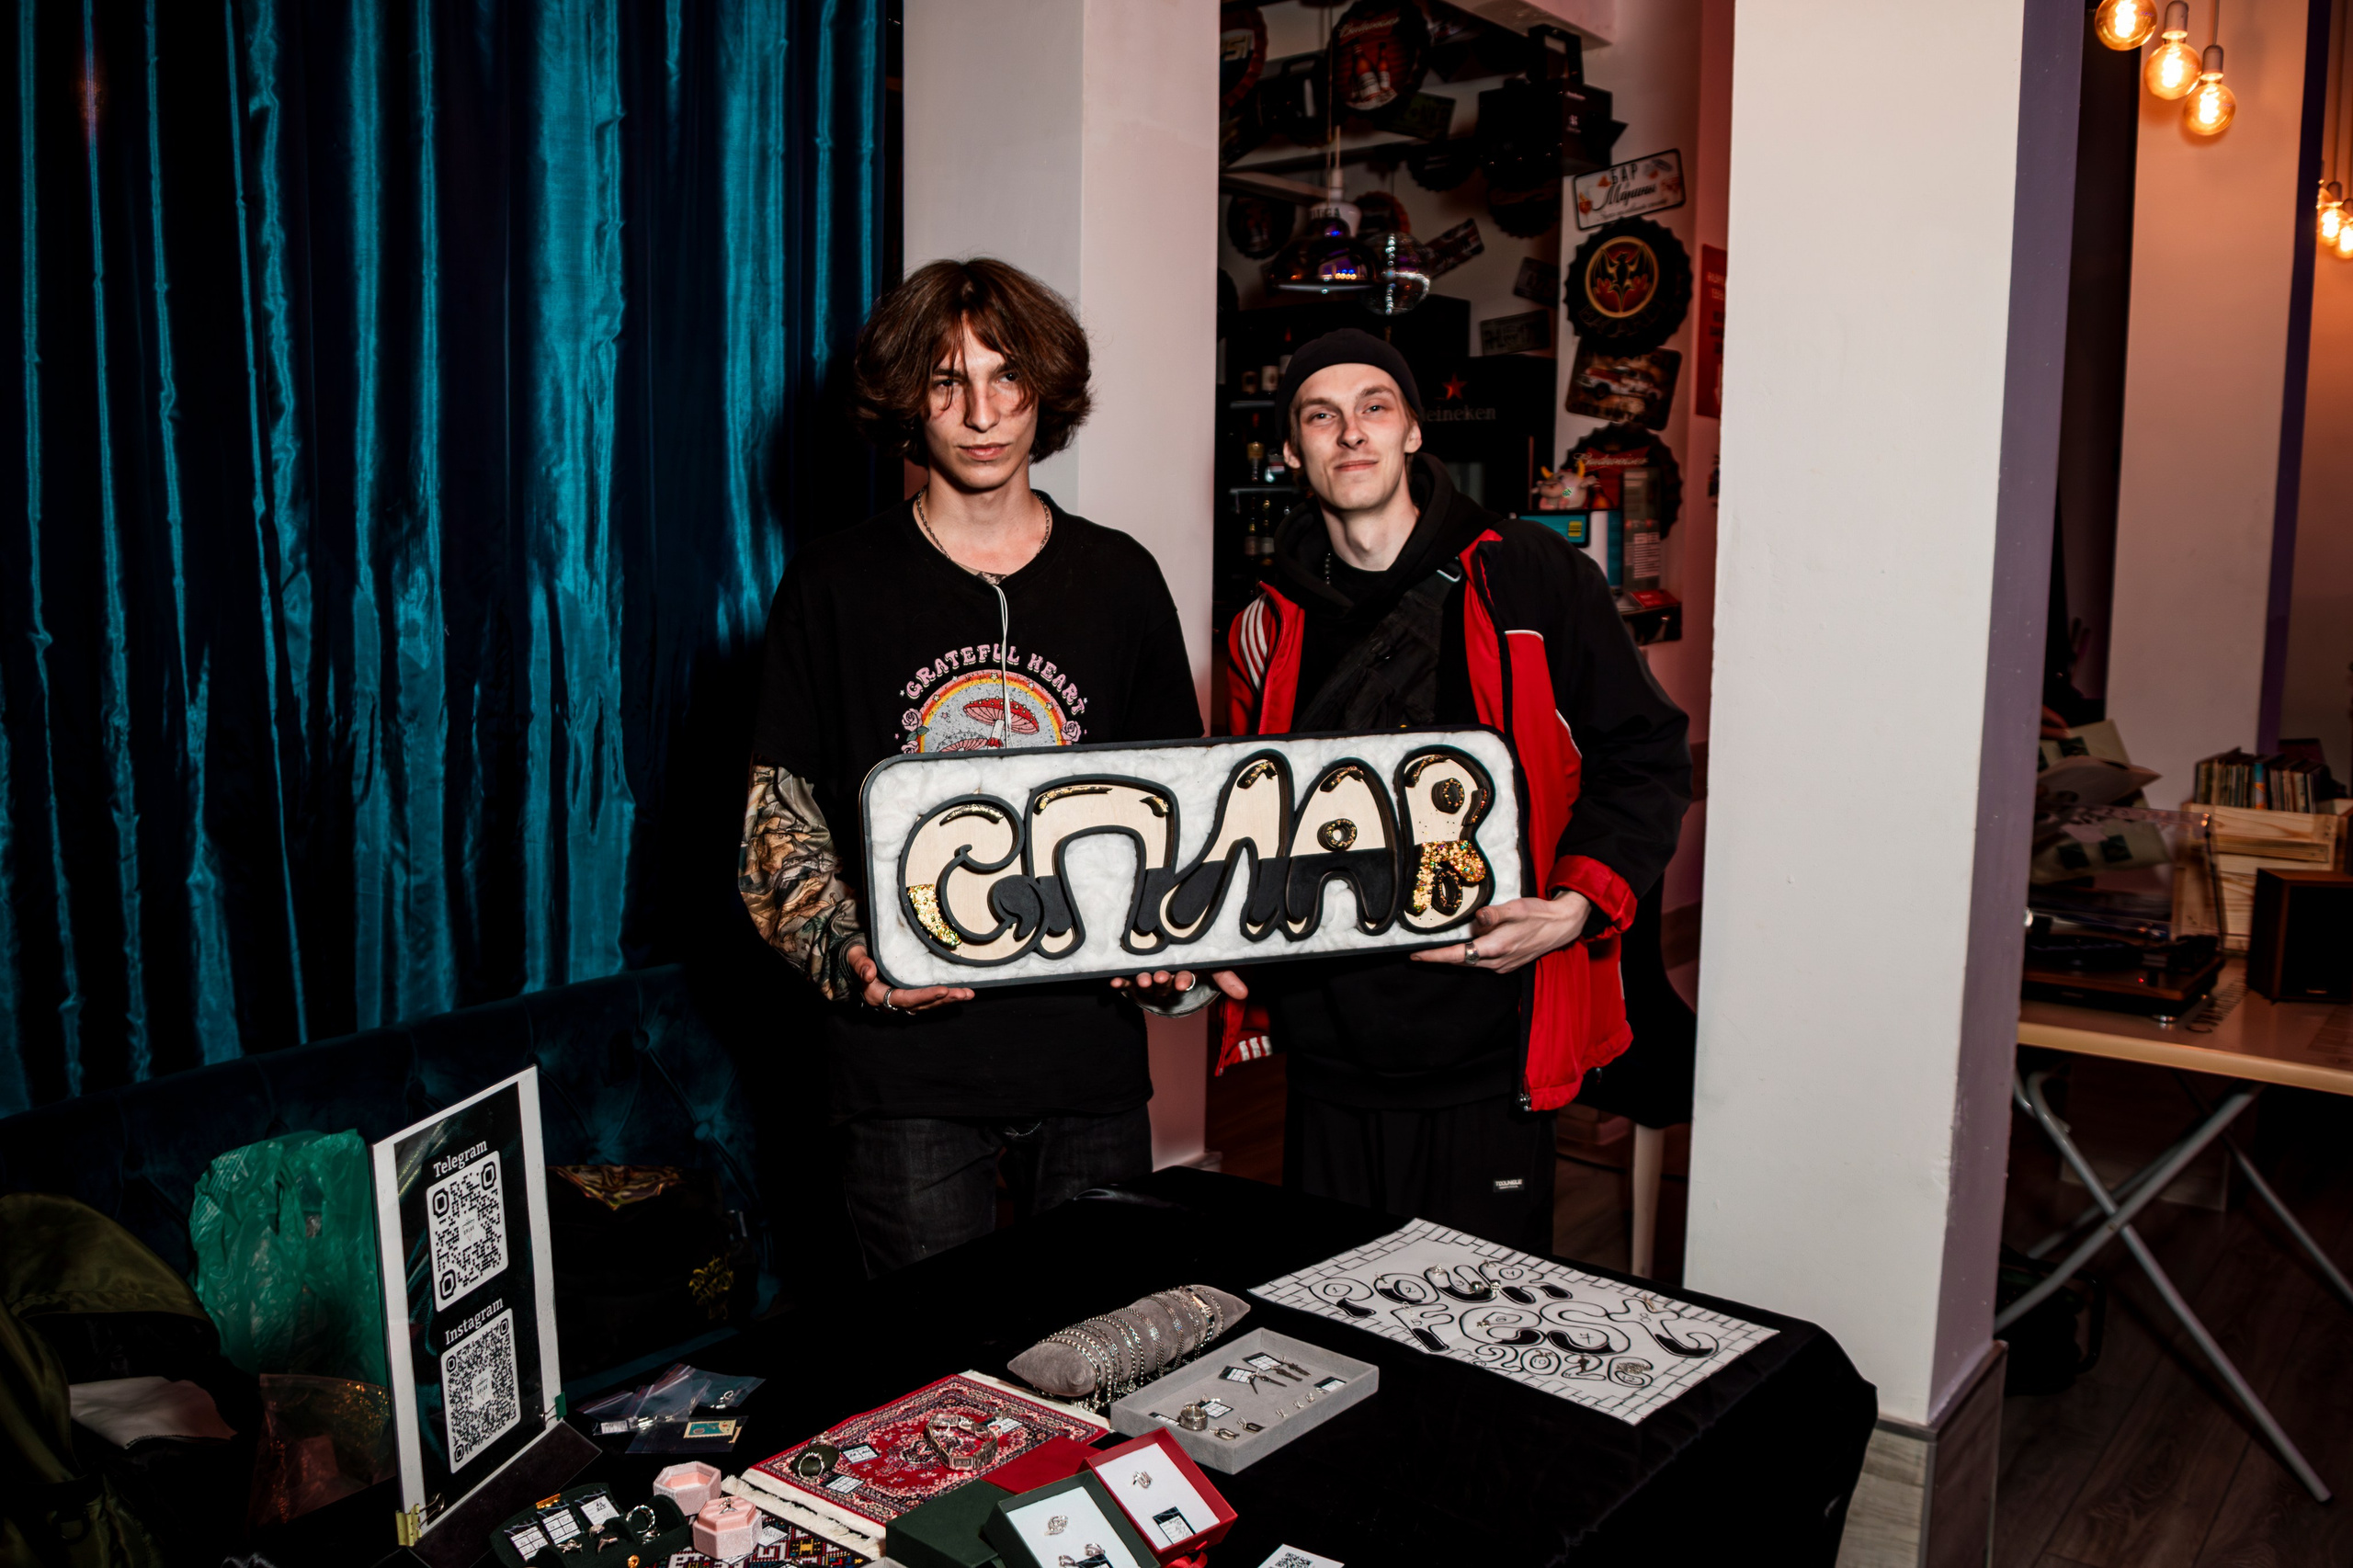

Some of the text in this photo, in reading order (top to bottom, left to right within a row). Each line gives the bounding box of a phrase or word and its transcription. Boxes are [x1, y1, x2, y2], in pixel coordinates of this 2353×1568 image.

[1609, 163, 1638, 186] БАР
[1421, 404, 1497, 423] eineken
[1027, 653, 1086, 716] HEART
[897, 744, 1496, 967] СПЛАВ
[433, 1141, 488, 1178] Telegram
[445, 1297, 505, 1346] Instagram
